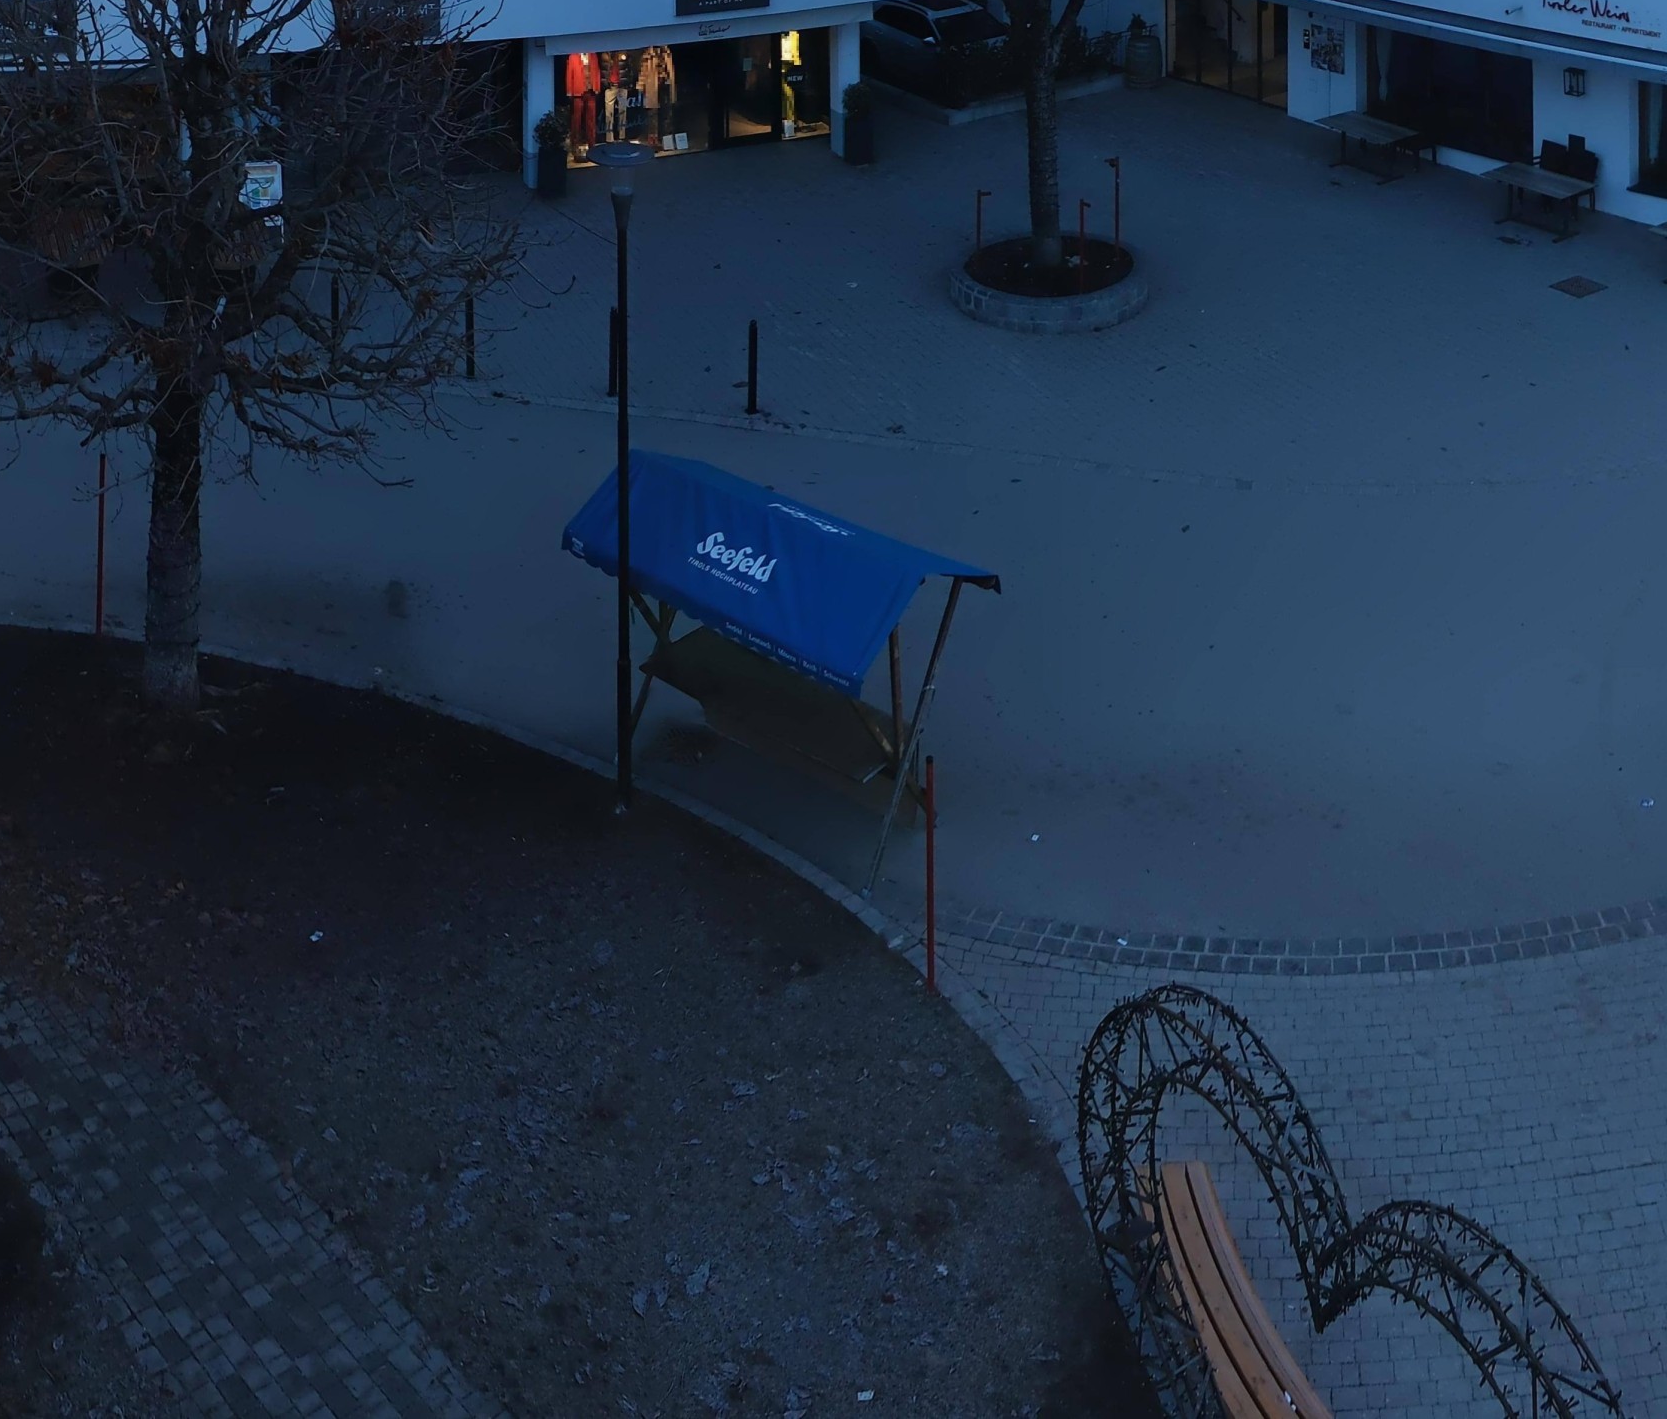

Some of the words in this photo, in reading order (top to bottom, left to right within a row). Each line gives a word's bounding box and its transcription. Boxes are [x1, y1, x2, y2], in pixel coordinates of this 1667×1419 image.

[687, 557, 710, 571] TIROLS
[710, 566, 758, 595] HOCHPLATEAU
[696, 532, 777, 582] Seefeld
